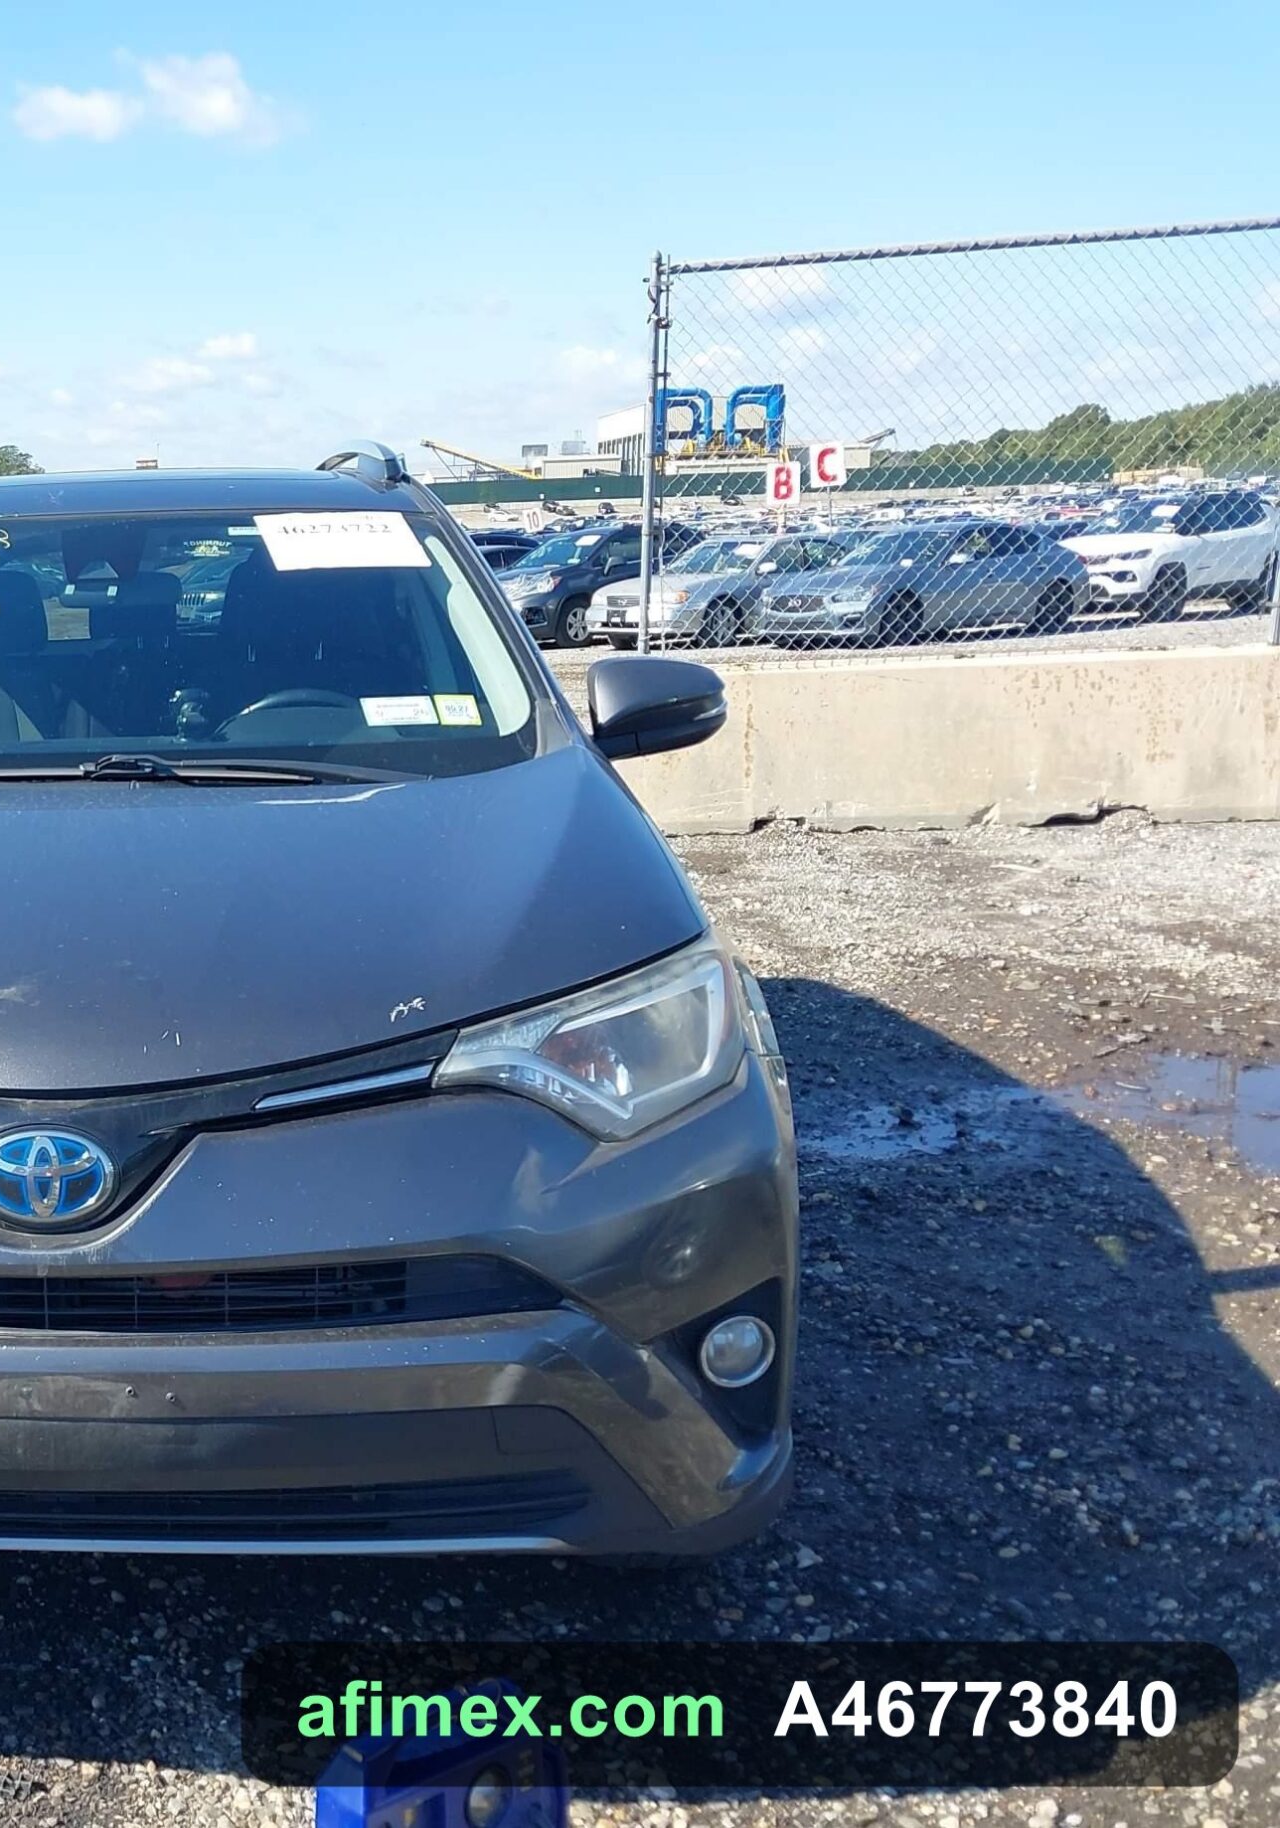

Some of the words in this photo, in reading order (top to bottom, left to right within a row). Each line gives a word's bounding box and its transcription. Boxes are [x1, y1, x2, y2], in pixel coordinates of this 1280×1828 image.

[817, 448, 838, 483] C
[773, 466, 793, 500] B
[526, 511, 540, 530] 10
